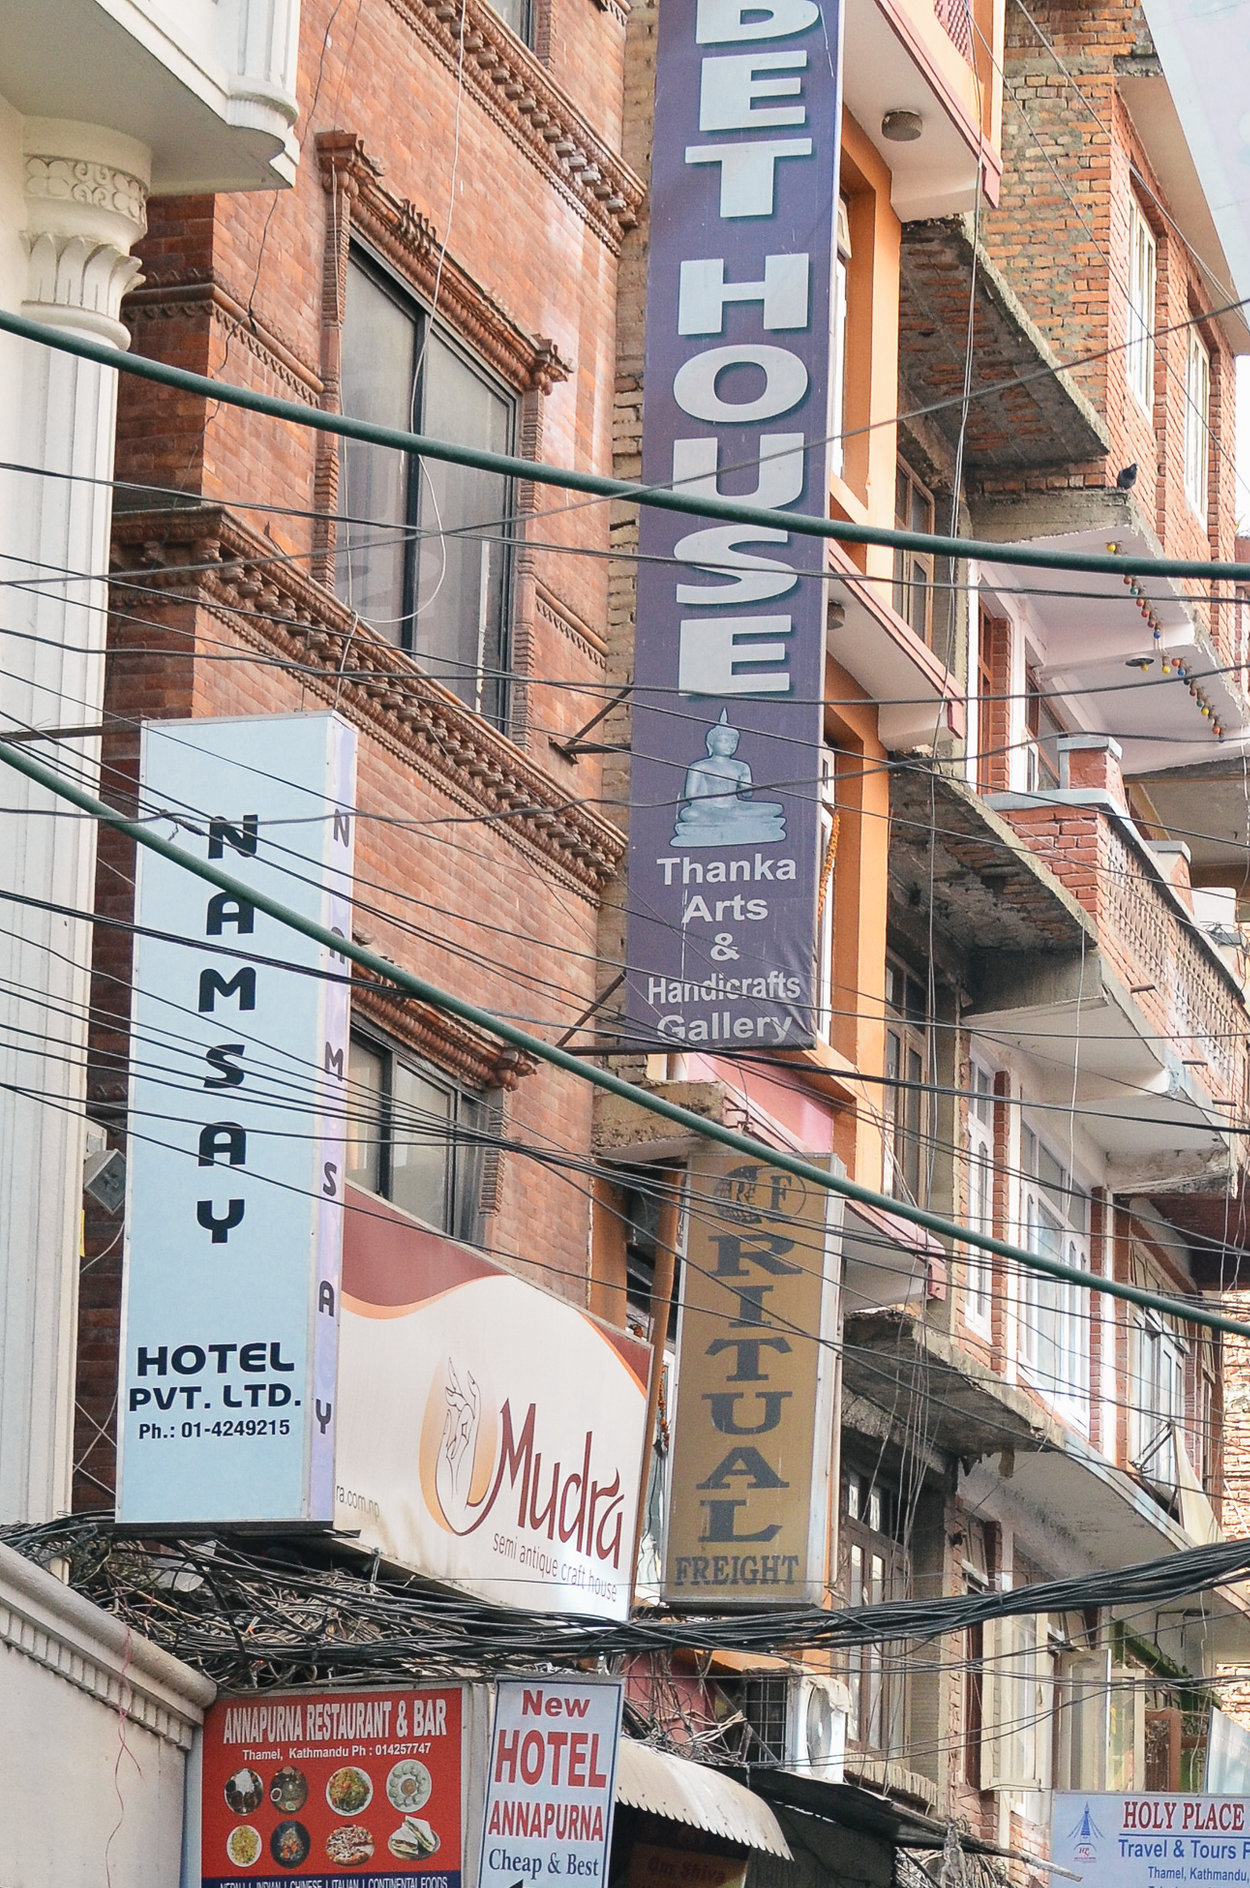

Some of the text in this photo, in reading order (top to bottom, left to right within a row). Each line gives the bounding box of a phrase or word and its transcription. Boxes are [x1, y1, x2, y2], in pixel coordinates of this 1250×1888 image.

[672, 252, 809, 697] HOUSE
[656, 853, 797, 886] Thanka
[681, 893, 769, 923] Arts
[648, 970, 801, 1005] Handicrafts
[196, 812, 259, 1245] NAMSAY
[656, 1012, 793, 1044] Gallery
[136, 1341, 296, 1378] HOTEL
[128, 1382, 302, 1412] PVT. LTD.
[696, 1232, 803, 1544] RITUAL
[138, 1418, 291, 1440] Ph.: 01-4249215
[488, 1397, 625, 1570] Mudra
[492, 1530, 617, 1603] semi antique craft house
[674, 1554, 800, 1587] FREIGHT
[521, 1689, 591, 1718] New
[222, 1698, 448, 1745] ANNAPURNA RESTAURANT BAR
[242, 1742, 432, 1762] Thamel, Kathmandu 014257747
[494, 1728, 607, 1789] HOTEL
[487, 1799, 604, 1843] ANNAPURNA
[1122, 1801, 1178, 1830] HOLY
[1182, 1802, 1245, 1832] PLACE
[488, 1847, 599, 1880] Cheap Best
[1118, 1838, 1169, 1859] Travel
[1190, 1839, 1237, 1860] Tours
[1148, 1866, 1187, 1881] Thamel,
[1189, 1867, 1250, 1883] Kathmandu,
